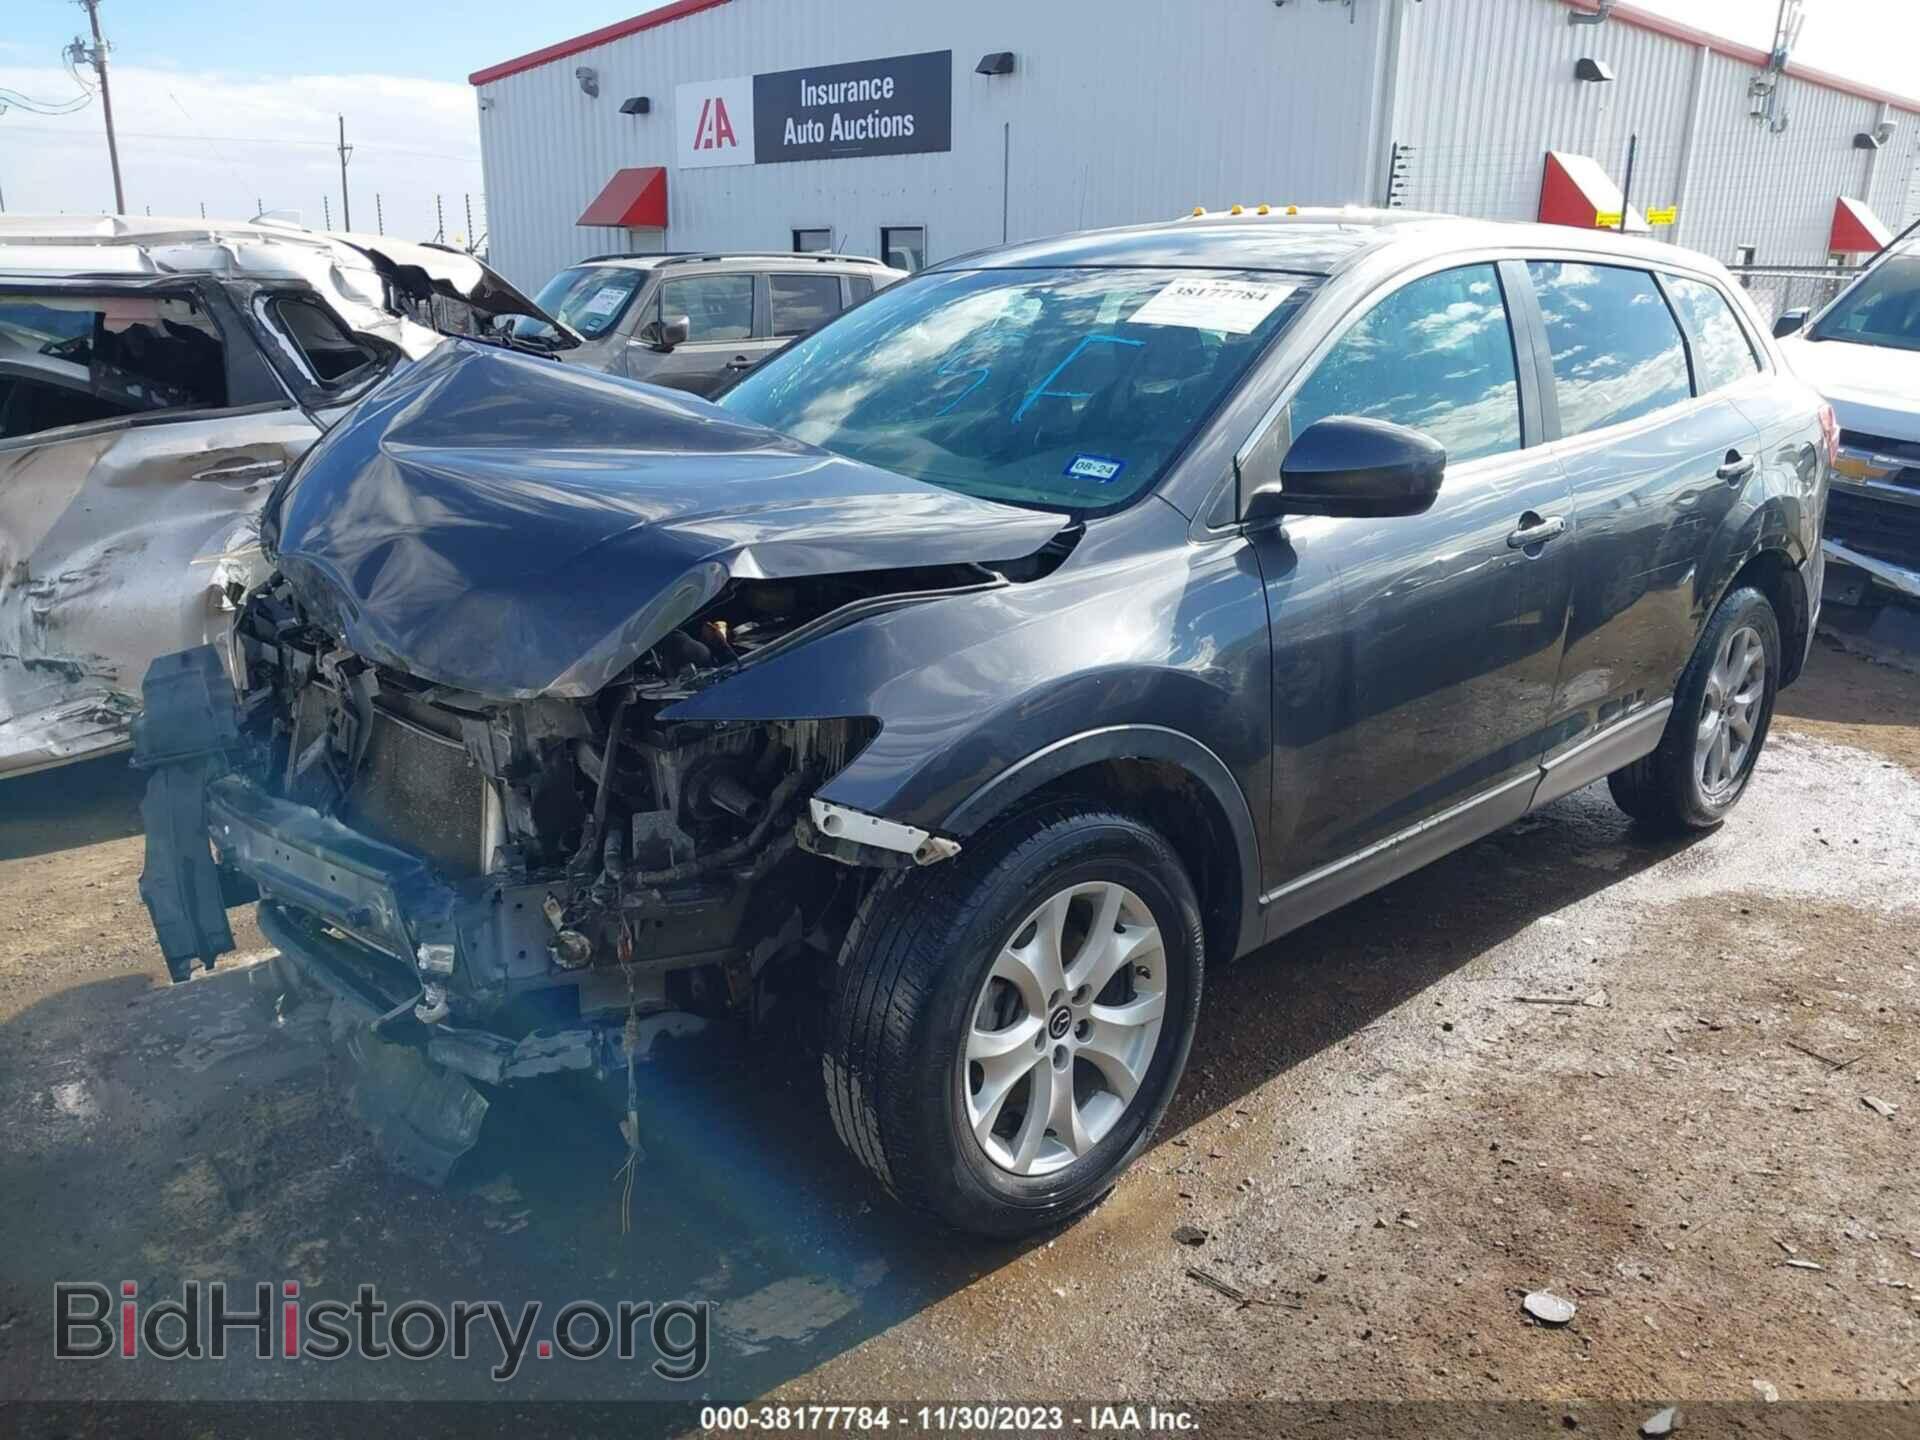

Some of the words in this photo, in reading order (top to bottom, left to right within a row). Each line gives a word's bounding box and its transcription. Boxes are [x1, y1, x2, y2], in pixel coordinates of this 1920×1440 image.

[801, 76, 894, 107] Insurance
[783, 117, 824, 145] Auto
[829, 109, 915, 142] Auctions
